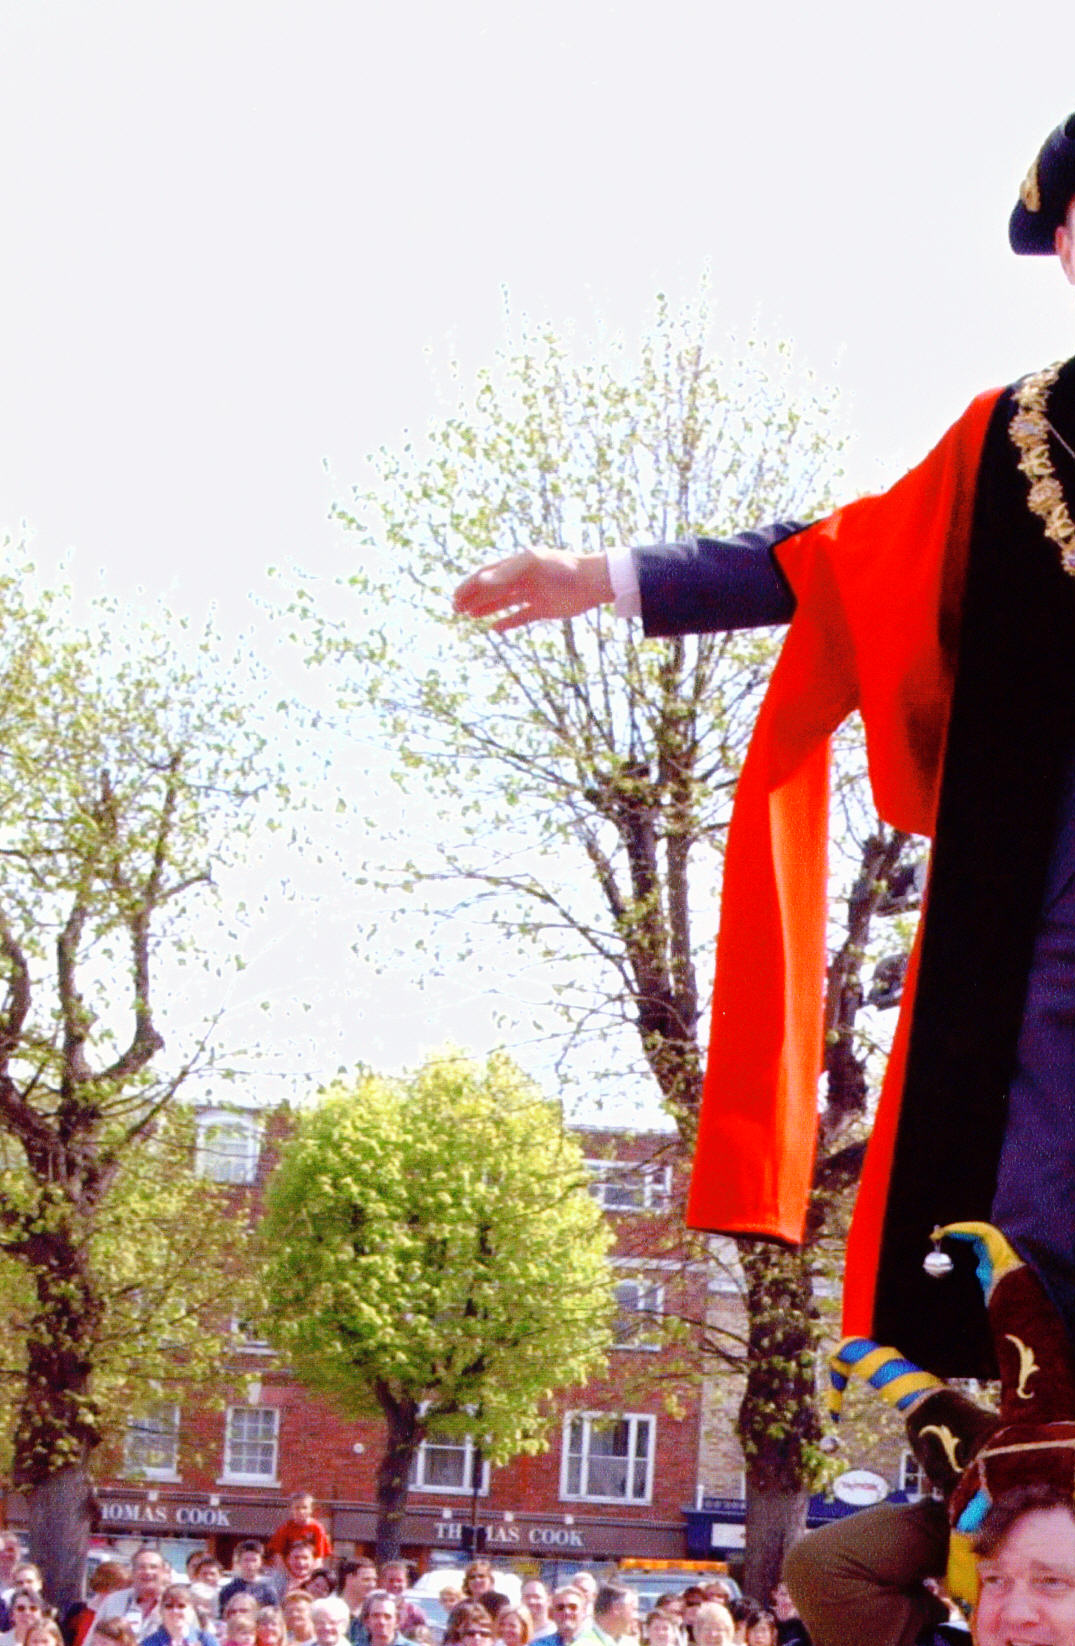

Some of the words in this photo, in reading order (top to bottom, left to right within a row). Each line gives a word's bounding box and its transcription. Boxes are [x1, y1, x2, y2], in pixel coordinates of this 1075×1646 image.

[176, 1506, 230, 1526] COOK
[435, 1522, 521, 1542] THAS
[529, 1528, 584, 1547] COOK
